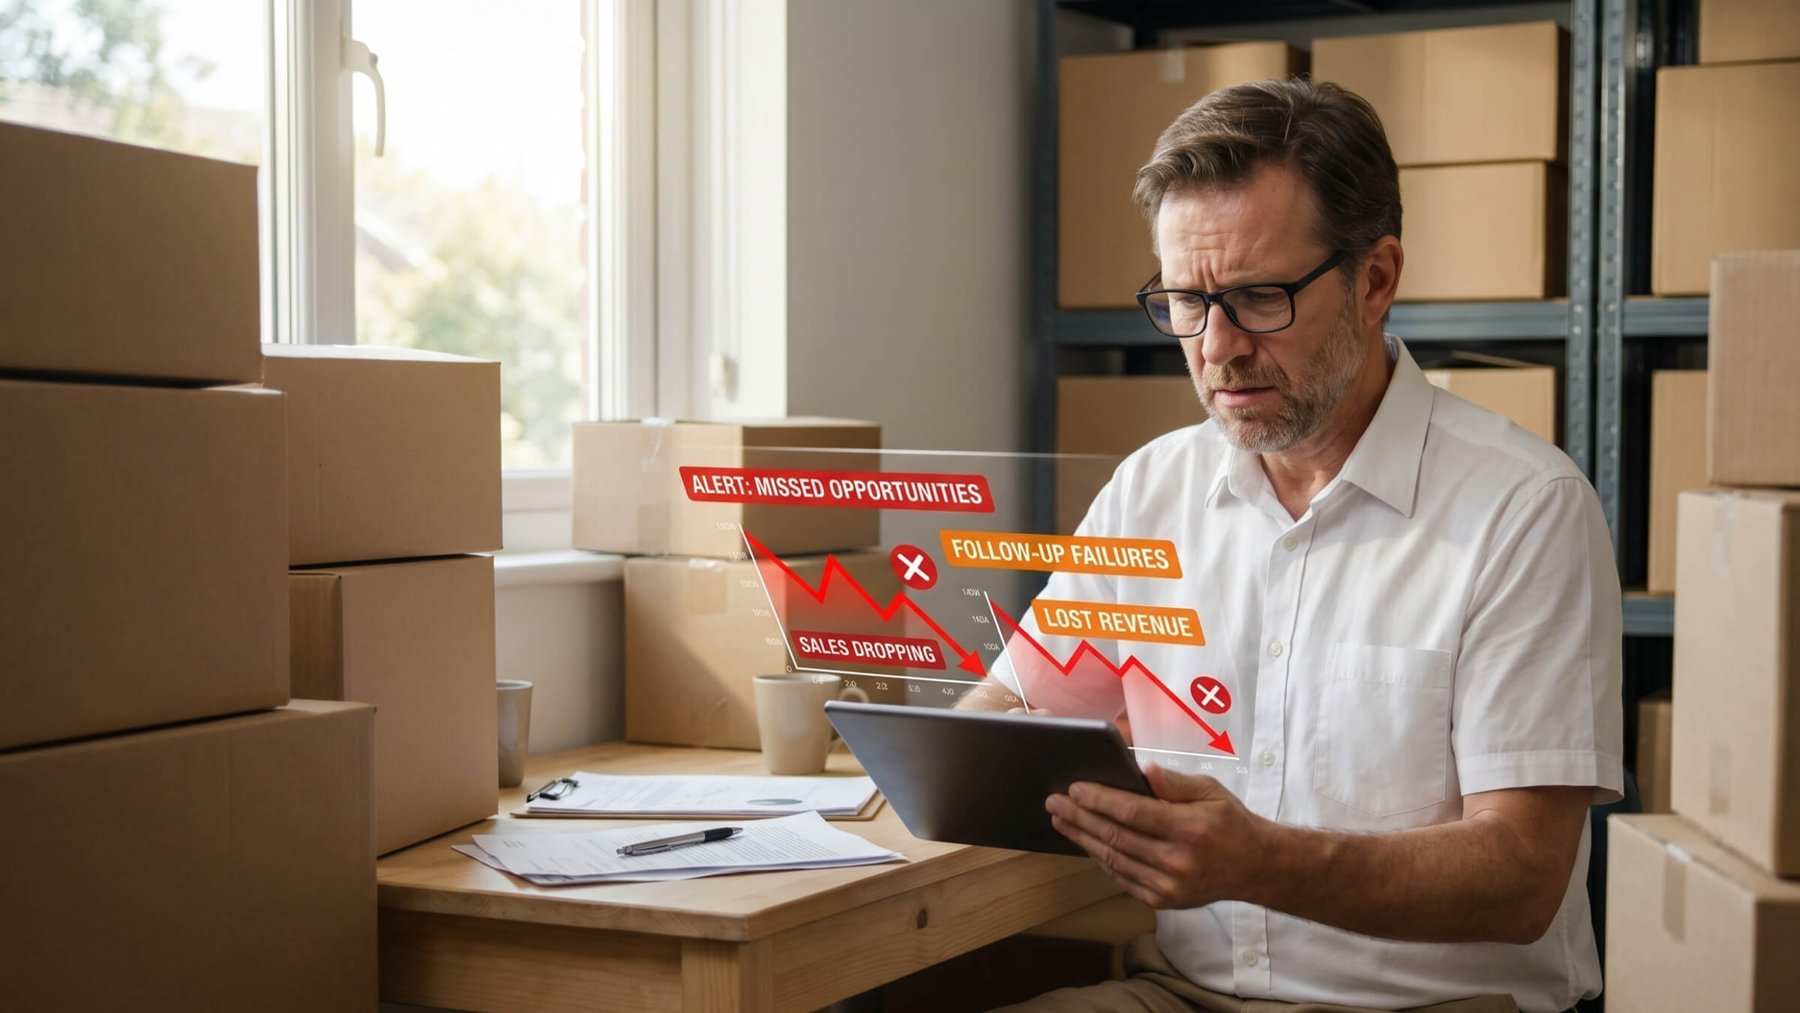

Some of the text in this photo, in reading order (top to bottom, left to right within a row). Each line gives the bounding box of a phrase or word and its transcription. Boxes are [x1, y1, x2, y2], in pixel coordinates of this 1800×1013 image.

[692, 474, 982, 504] ALERT: MISSED OPPORTUNITIES
[951, 539, 1170, 570] FOLLOW-UP FAILURES
[1043, 607, 1193, 637] LOST REVENUE
[799, 636, 936, 664] SALES DROPPING
